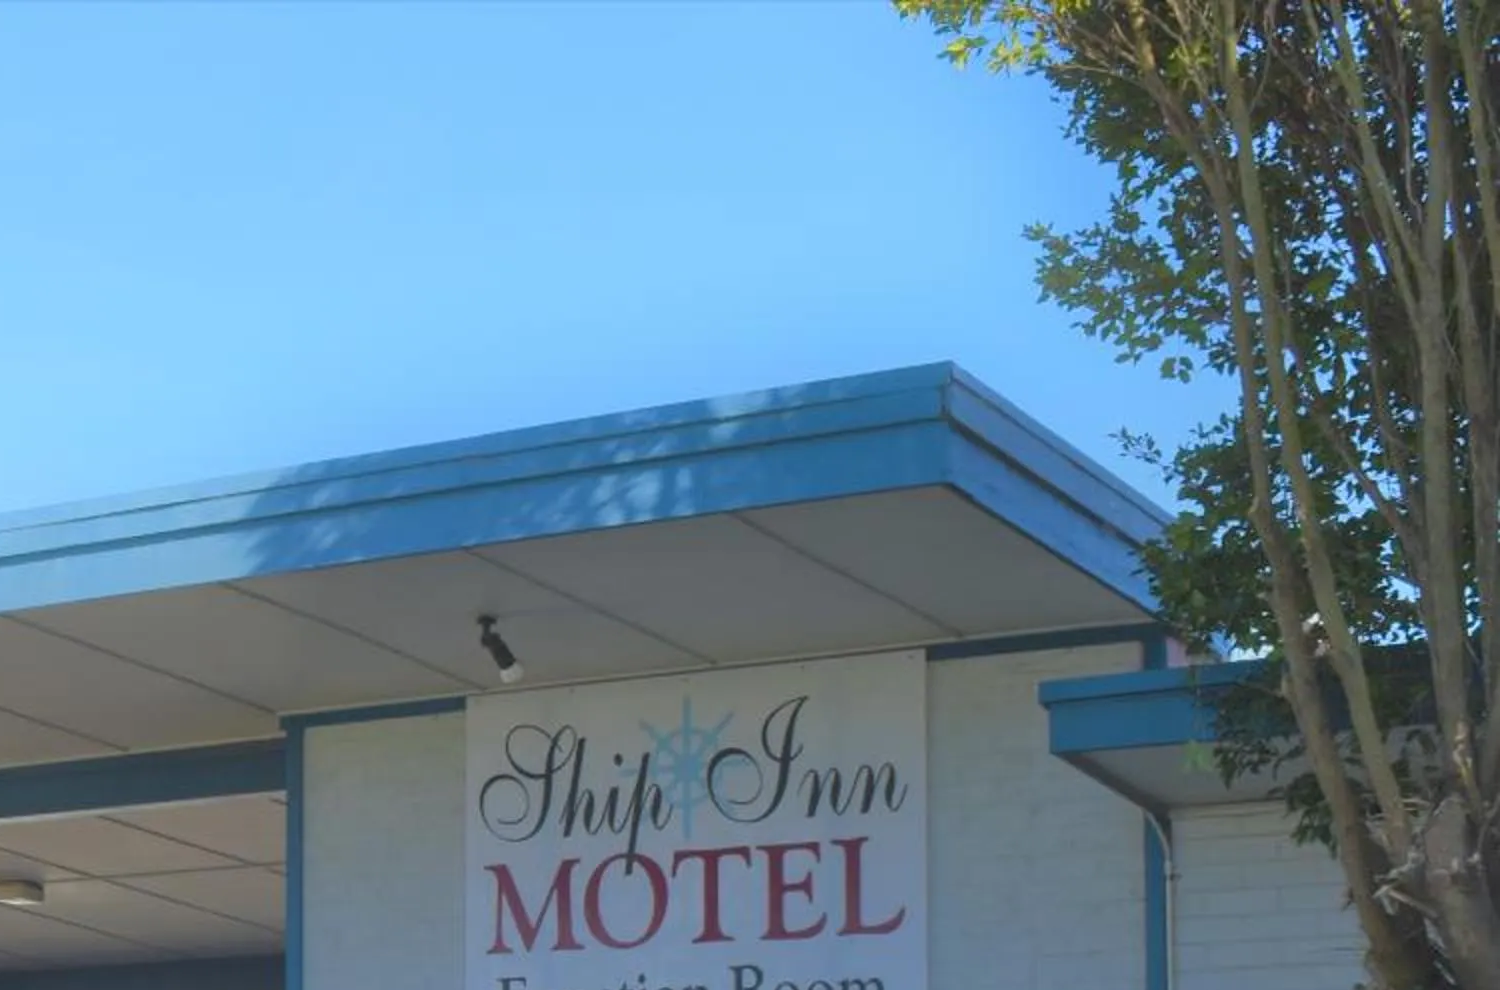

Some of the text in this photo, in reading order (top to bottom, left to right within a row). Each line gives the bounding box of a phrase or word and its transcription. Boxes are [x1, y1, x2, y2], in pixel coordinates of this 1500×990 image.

[479, 696, 907, 876] Ship Inn
[483, 836, 906, 955] MOTEL
